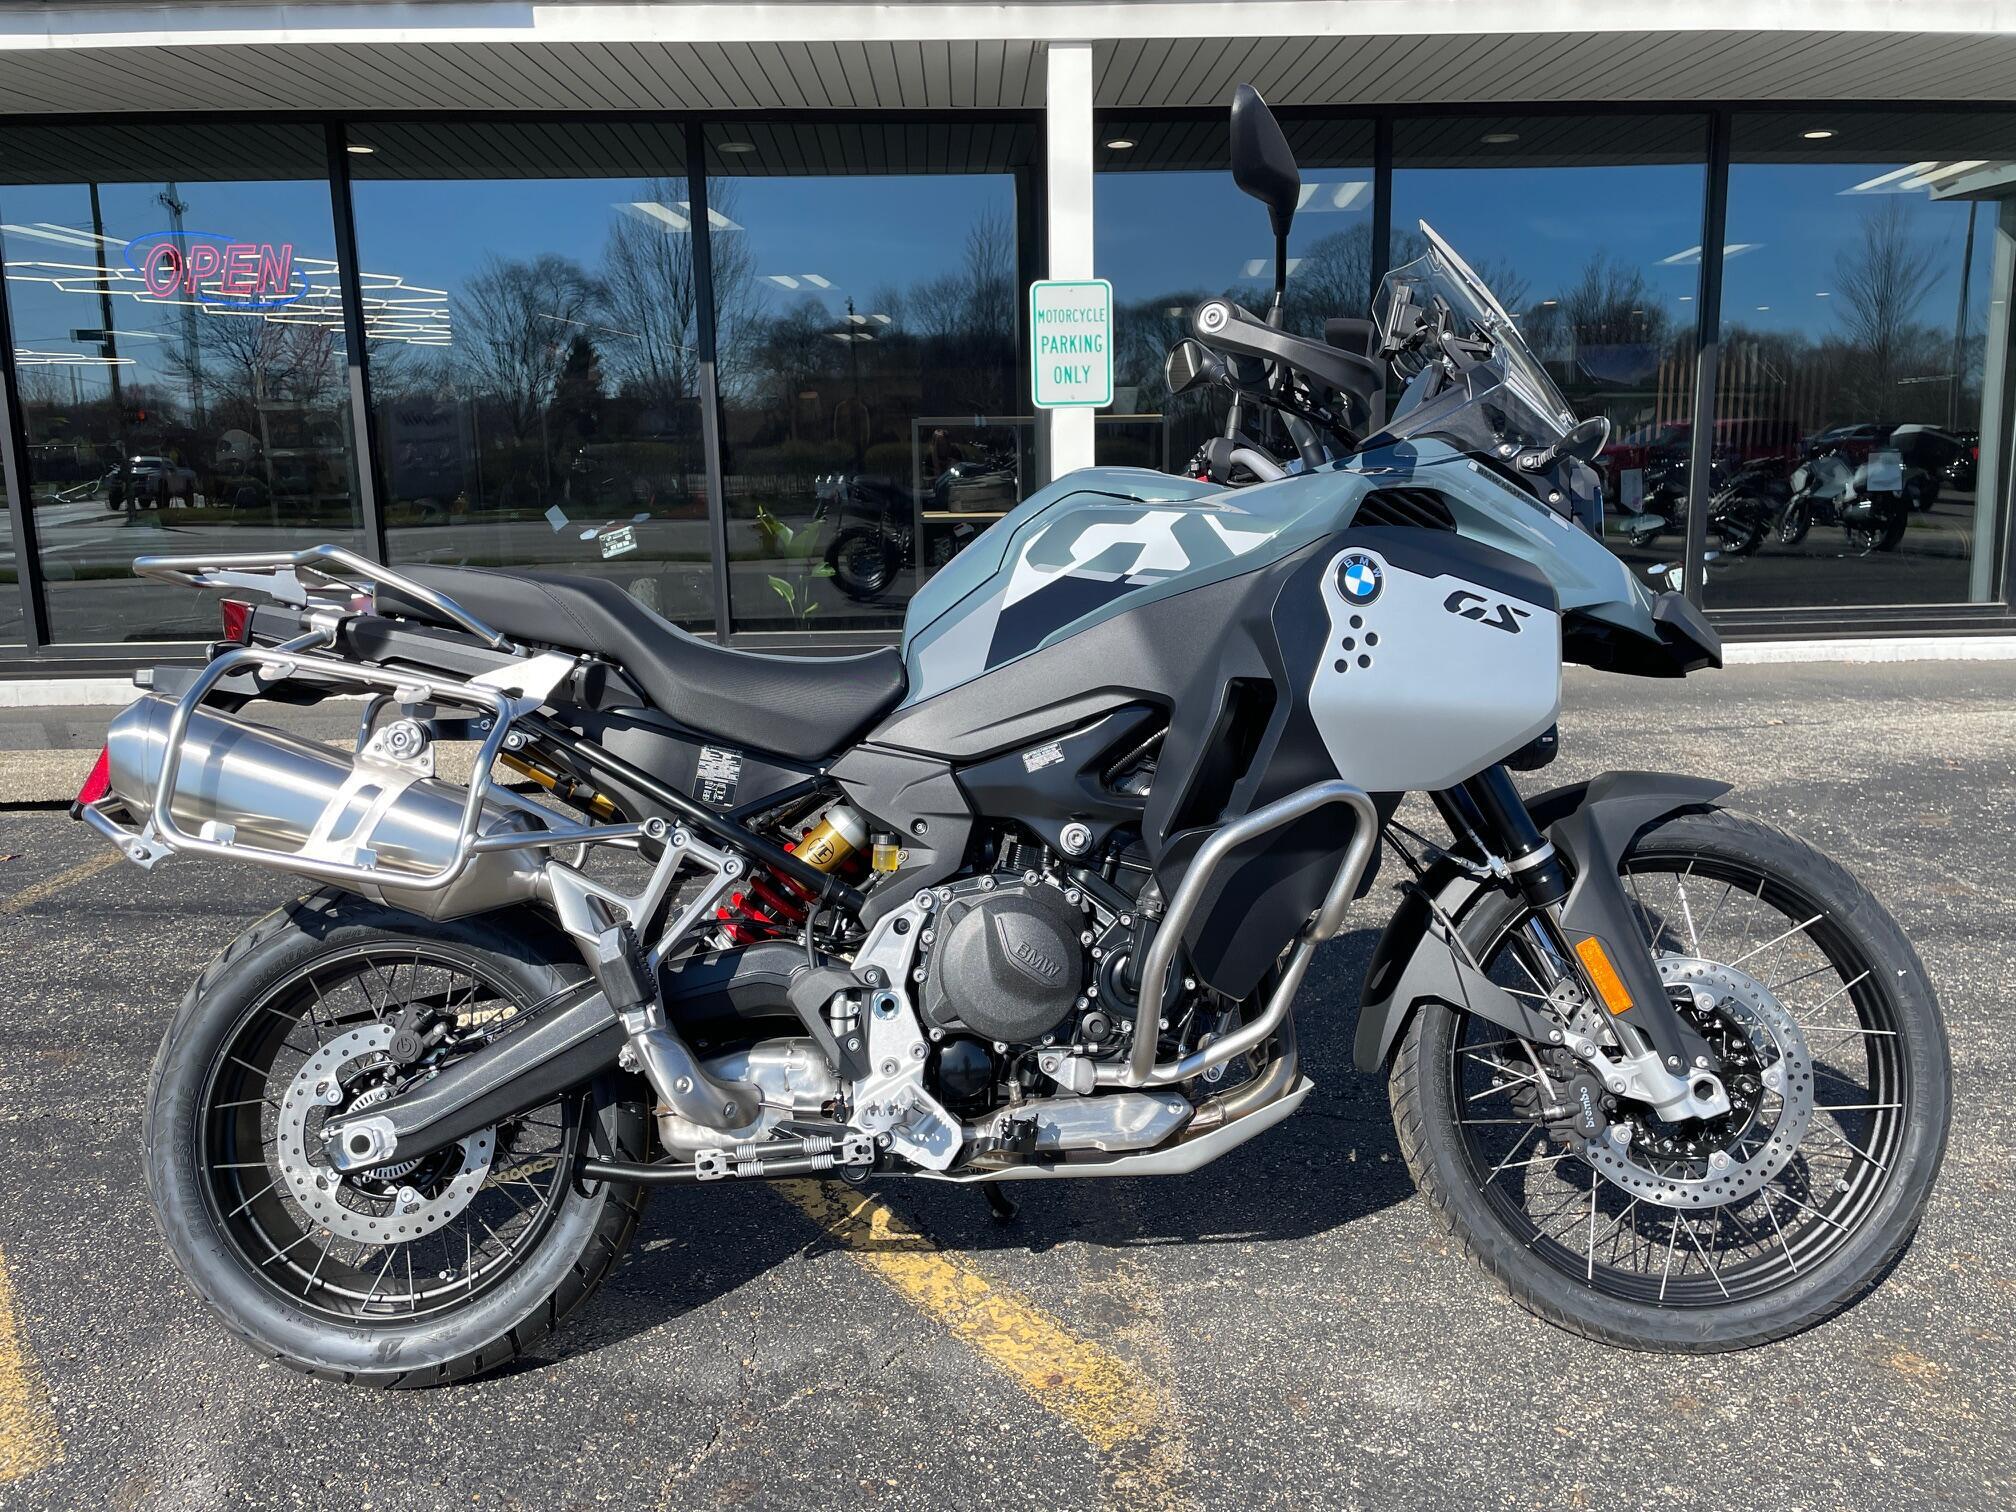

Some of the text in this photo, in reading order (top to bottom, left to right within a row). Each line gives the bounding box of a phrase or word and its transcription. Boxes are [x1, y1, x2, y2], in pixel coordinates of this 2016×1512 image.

[144, 243, 292, 297] OPEN
[1038, 308, 1105, 323] MOTORCYCLE
[1041, 335, 1103, 354] PARKING
[1053, 365, 1091, 384] ONLY
[1344, 556, 1383, 578] BMW
[1443, 590, 1532, 634] GS
[1015, 941, 1062, 978] BMW
[1580, 1086, 1595, 1128] brembo
